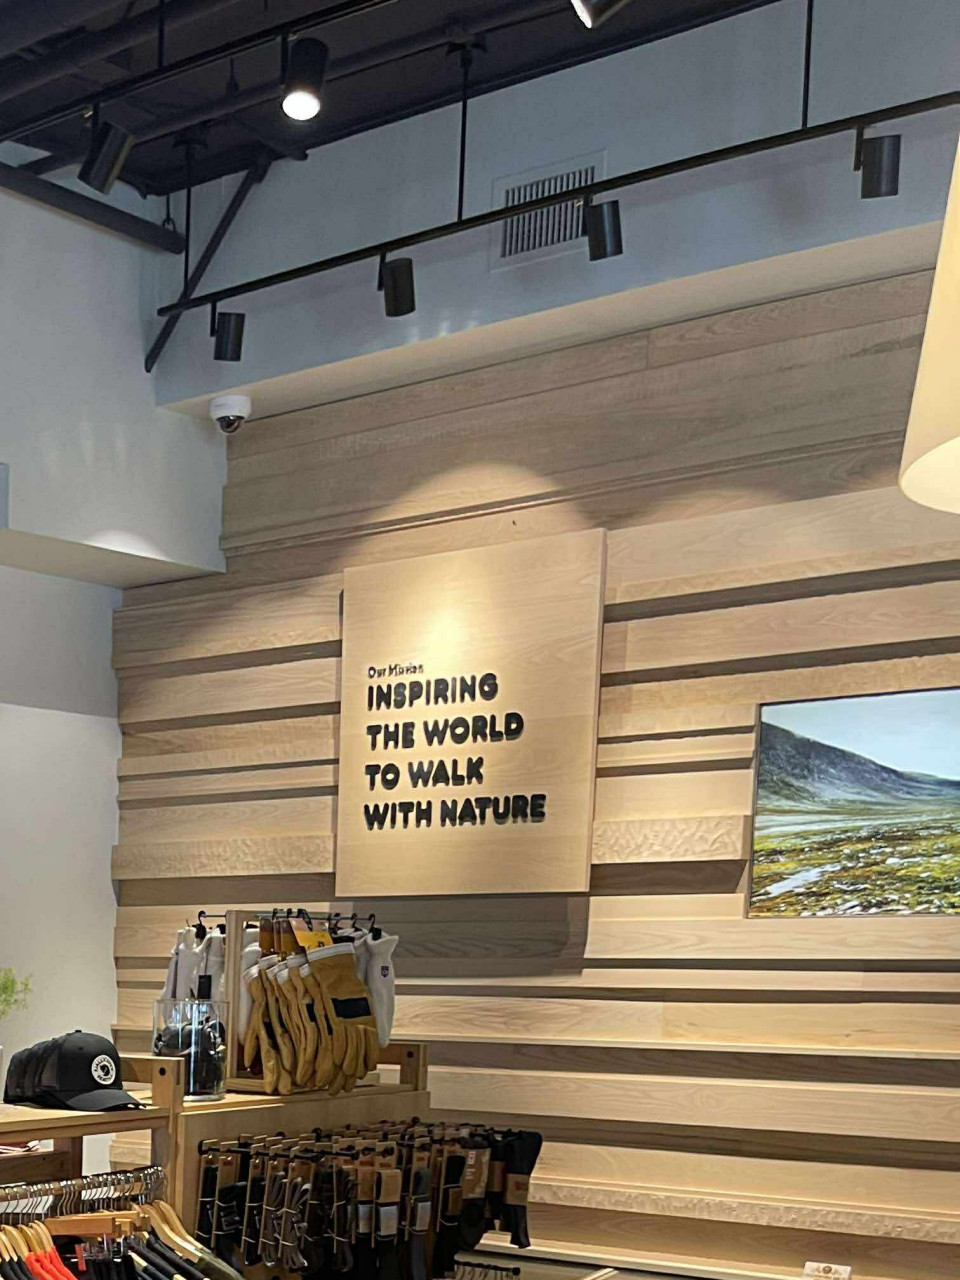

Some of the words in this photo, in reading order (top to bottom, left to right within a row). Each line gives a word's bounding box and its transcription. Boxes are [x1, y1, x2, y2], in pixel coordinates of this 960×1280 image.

[368, 666, 386, 678] Our
[367, 672, 499, 711] INSPIRING
[366, 721, 416, 751] THE
[423, 712, 524, 746] WORLD
[365, 763, 400, 791] TO
[407, 756, 484, 788] WALK
[364, 800, 433, 831] WITH
[440, 794, 547, 827] NATURE
